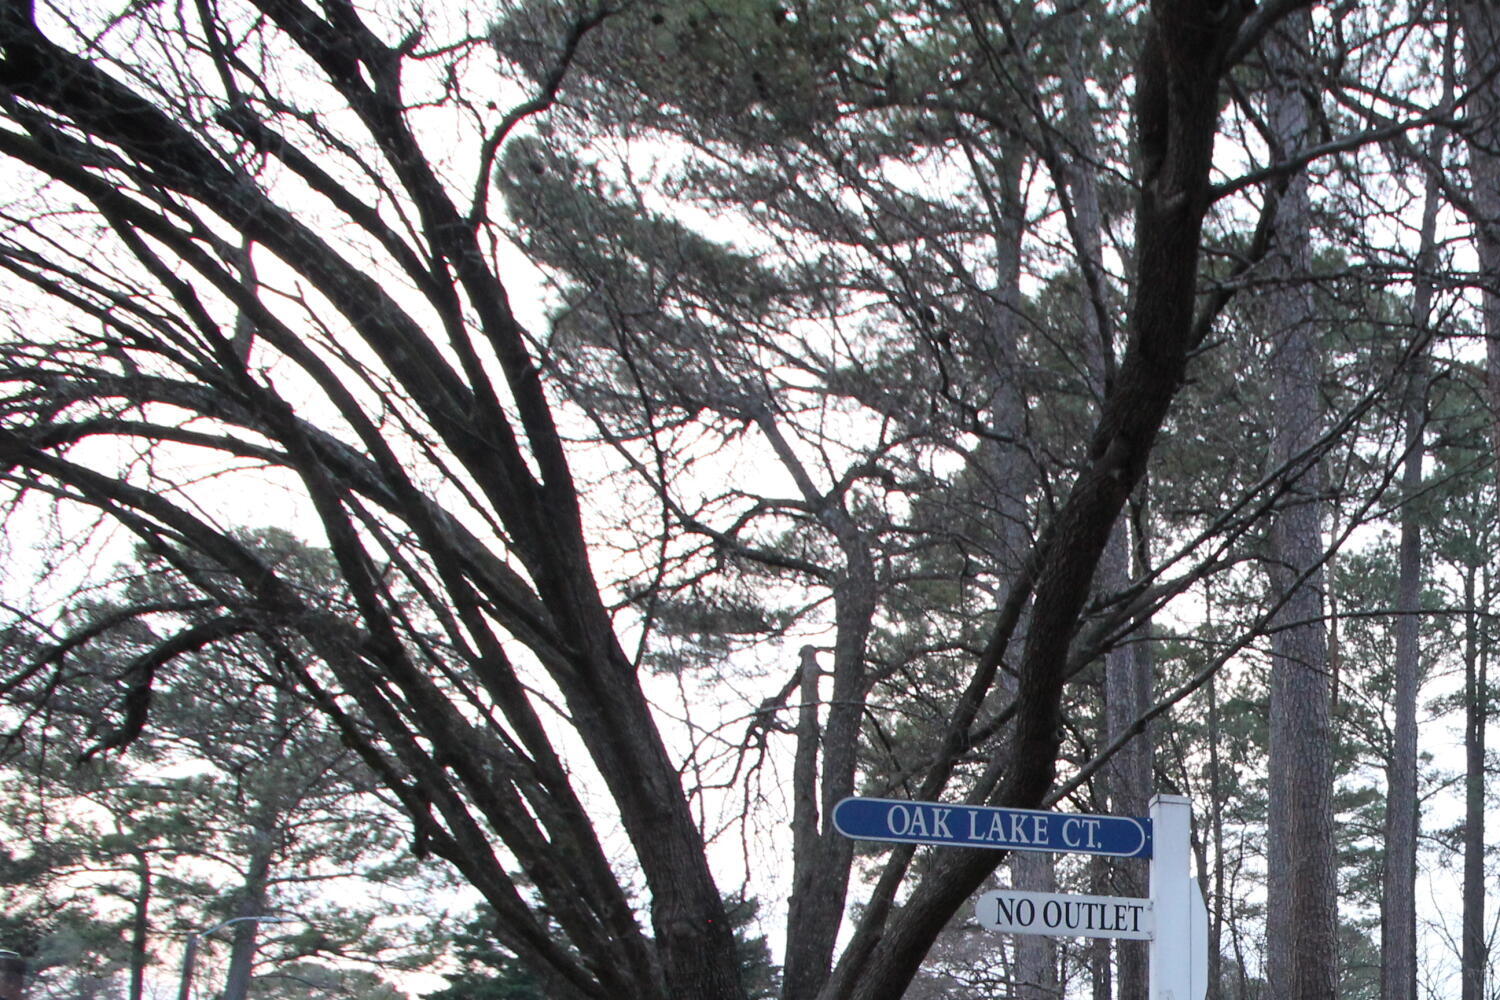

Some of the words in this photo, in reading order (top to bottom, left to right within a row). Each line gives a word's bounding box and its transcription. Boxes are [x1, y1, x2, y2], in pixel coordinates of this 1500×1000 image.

[887, 804, 954, 838] OAK
[967, 810, 1049, 845] LAKE
[1062, 818, 1102, 849] CT.
[995, 897, 1036, 927] NO
[1043, 900, 1144, 932] OUTLET
